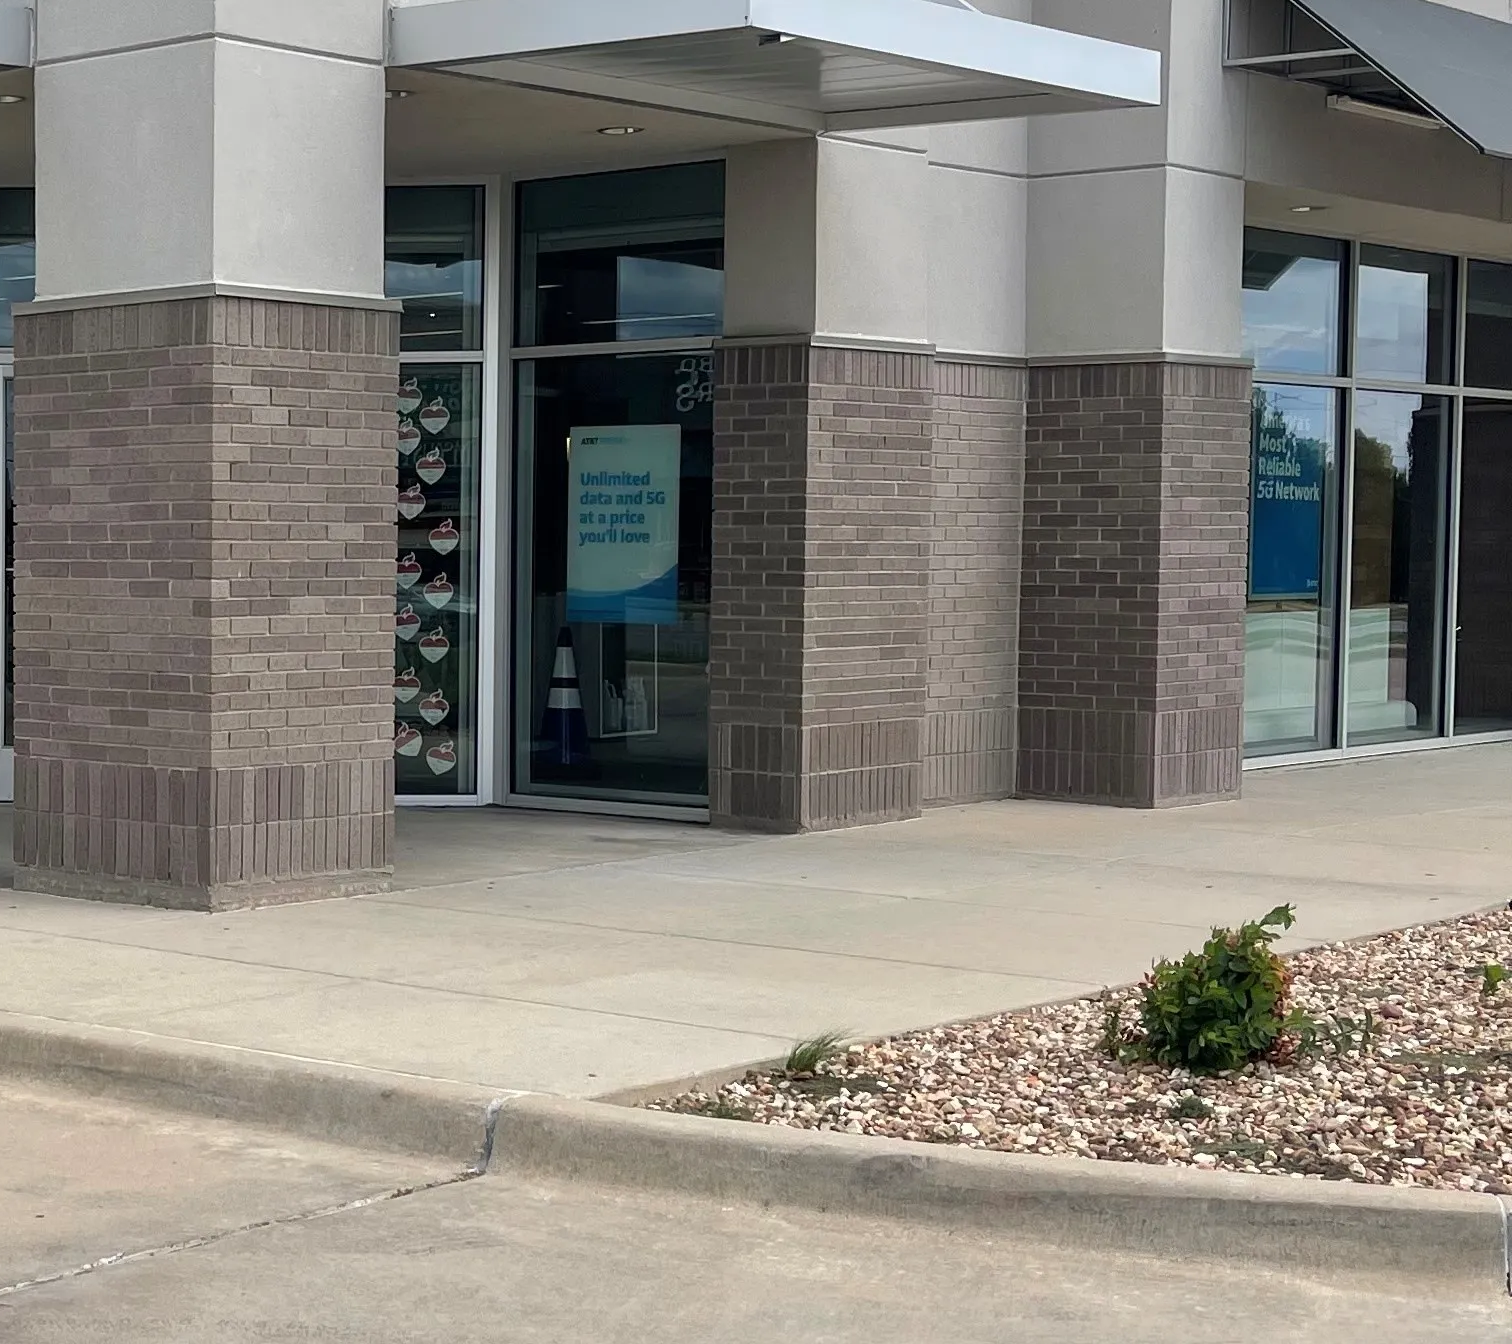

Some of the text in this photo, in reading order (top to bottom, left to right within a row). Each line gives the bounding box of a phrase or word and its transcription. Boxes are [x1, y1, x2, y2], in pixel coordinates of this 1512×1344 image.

[1259, 432, 1287, 453] Most
[1258, 456, 1302, 477] Reliable
[580, 471, 650, 486] Unlimited
[580, 490, 666, 505] data and 5G
[1256, 479, 1320, 501] 5G Network
[579, 510, 645, 527] at a price
[578, 529, 650, 546] you'll love
